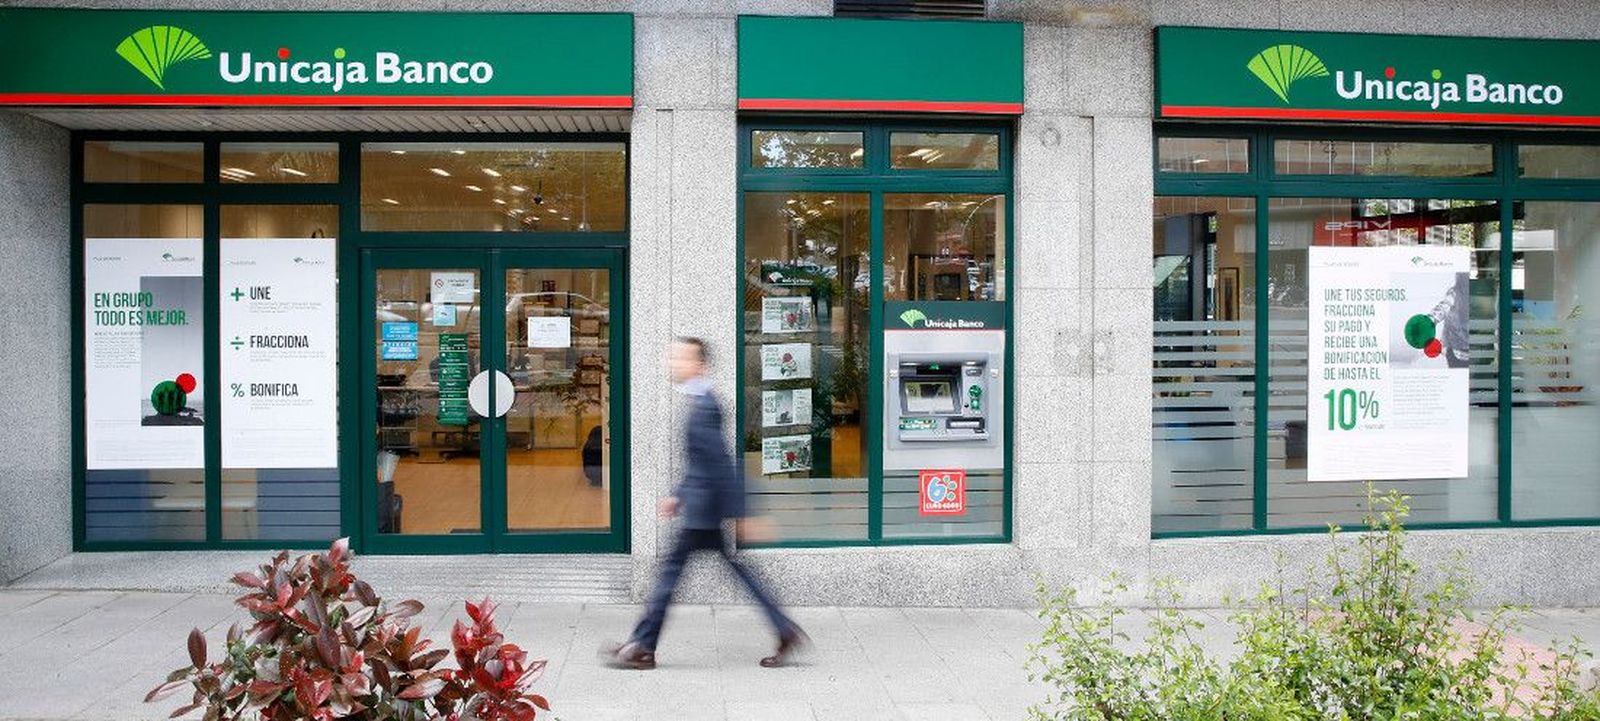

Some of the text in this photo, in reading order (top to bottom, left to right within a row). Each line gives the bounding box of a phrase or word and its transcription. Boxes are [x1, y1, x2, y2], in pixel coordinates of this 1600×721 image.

[220, 48, 493, 92] Unicaja Banco
[1336, 67, 1563, 110] Unicaja Banco
[94, 292, 153, 308] EN GRUPO
[250, 286, 271, 300] UNE
[1324, 288, 1342, 301] UNE
[1345, 288, 1362, 301] TUS
[1324, 304, 1375, 317] FRACCIONA
[94, 310, 189, 326] TODO ES MEJOR.
[924, 318, 984, 329] Unicaja Banco
[1324, 320, 1371, 333] SU PAGO Y
[250, 335, 309, 349] FRACCIONA
[1324, 335, 1378, 348] RECIBE UNA
[1324, 367, 1382, 380] DE HASTA EL
[250, 383, 299, 397] BONIFICA
[1323, 388, 1379, 431] 10%
